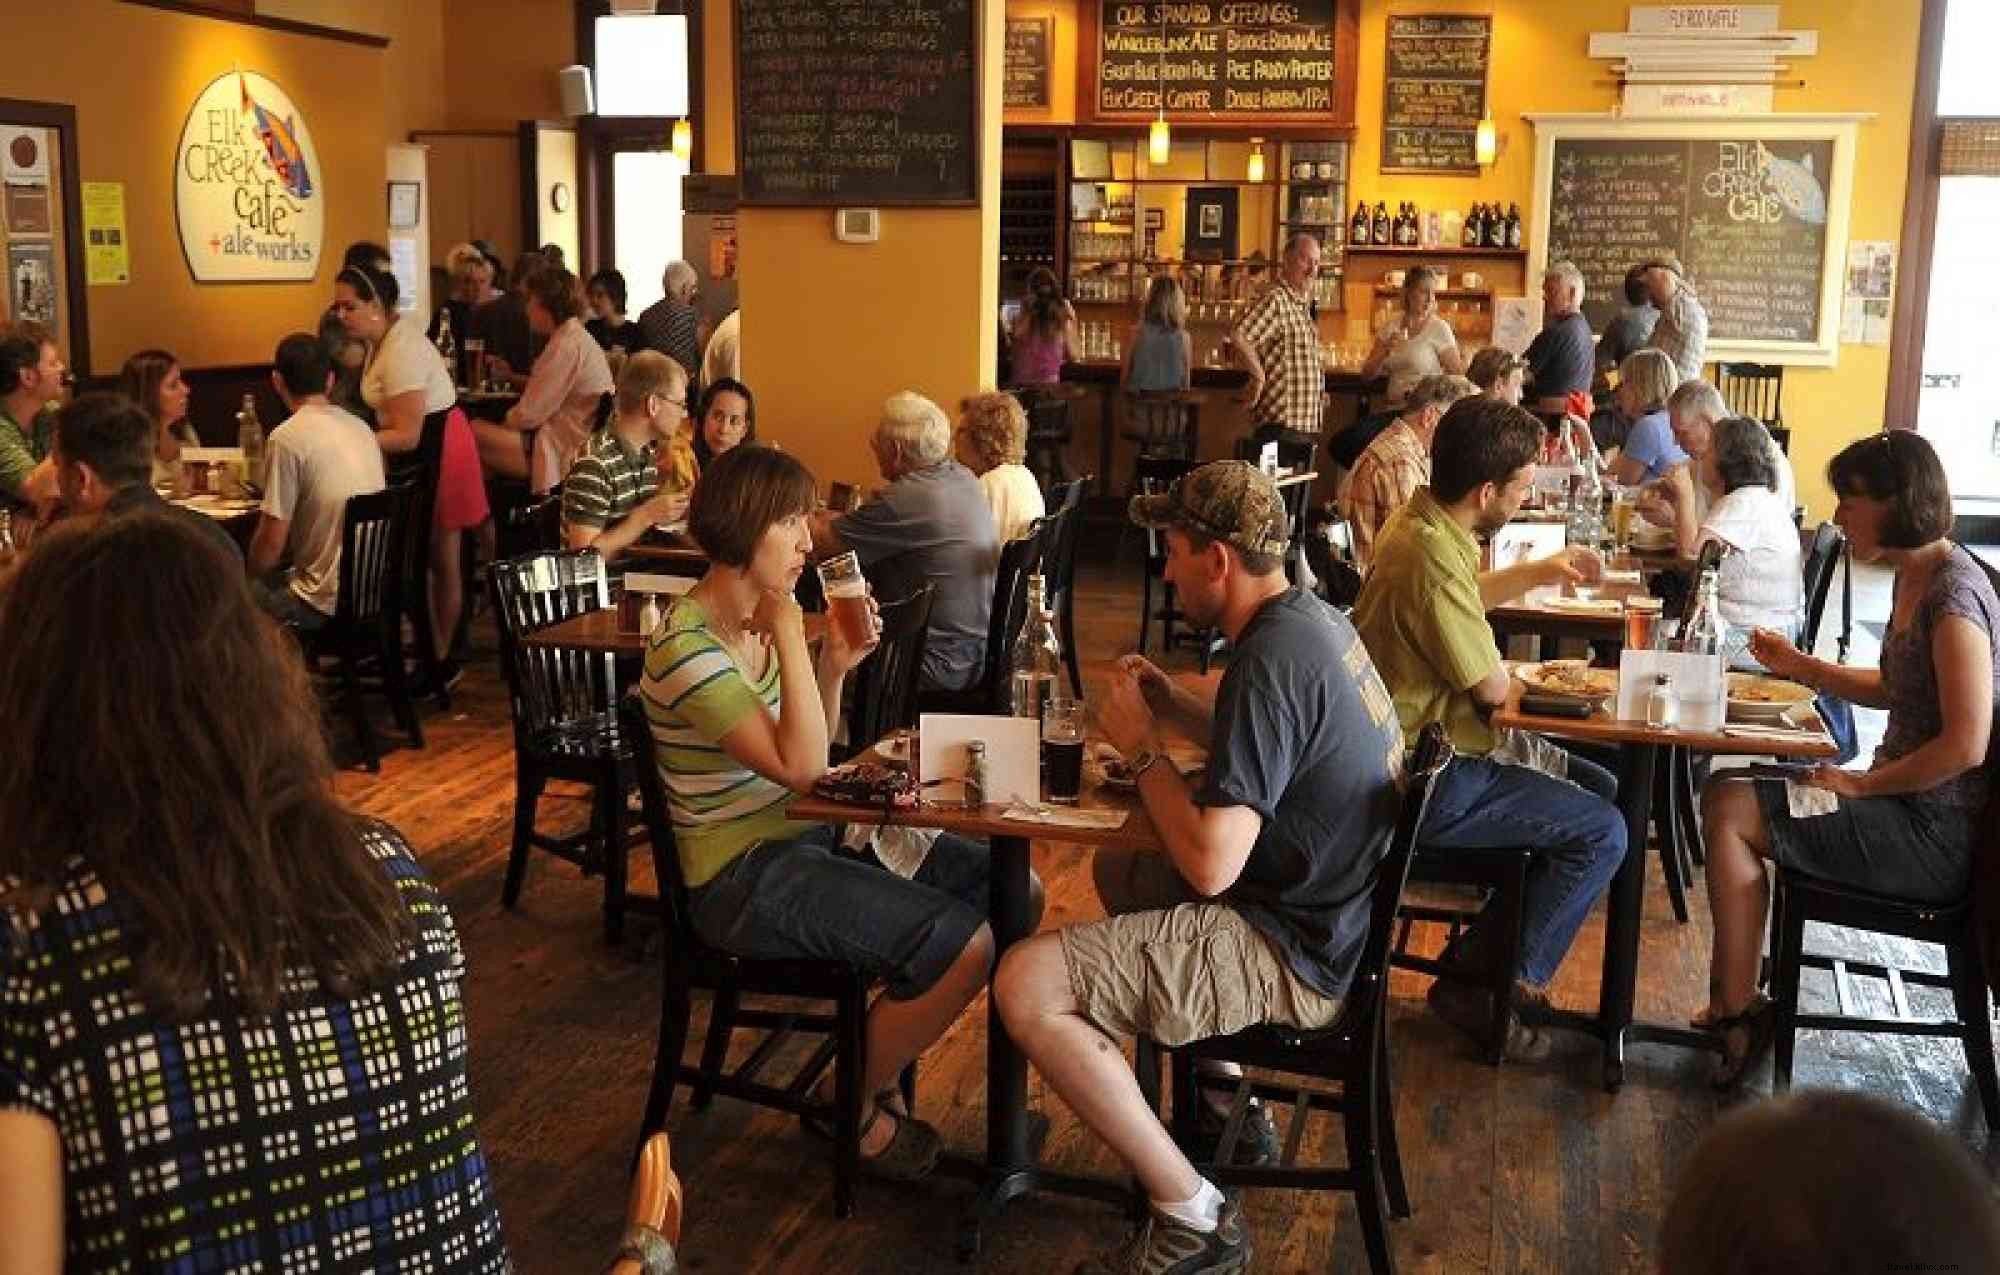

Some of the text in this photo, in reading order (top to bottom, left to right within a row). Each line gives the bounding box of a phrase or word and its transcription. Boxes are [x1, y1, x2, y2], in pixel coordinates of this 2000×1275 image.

[1116, 6, 1146, 25] OUR
[1219, 3, 1299, 24] OFFERINGS:
[1190, 31, 1218, 51] ALE
[1227, 59, 1251, 81] POE
[206, 108, 245, 146] Elk
